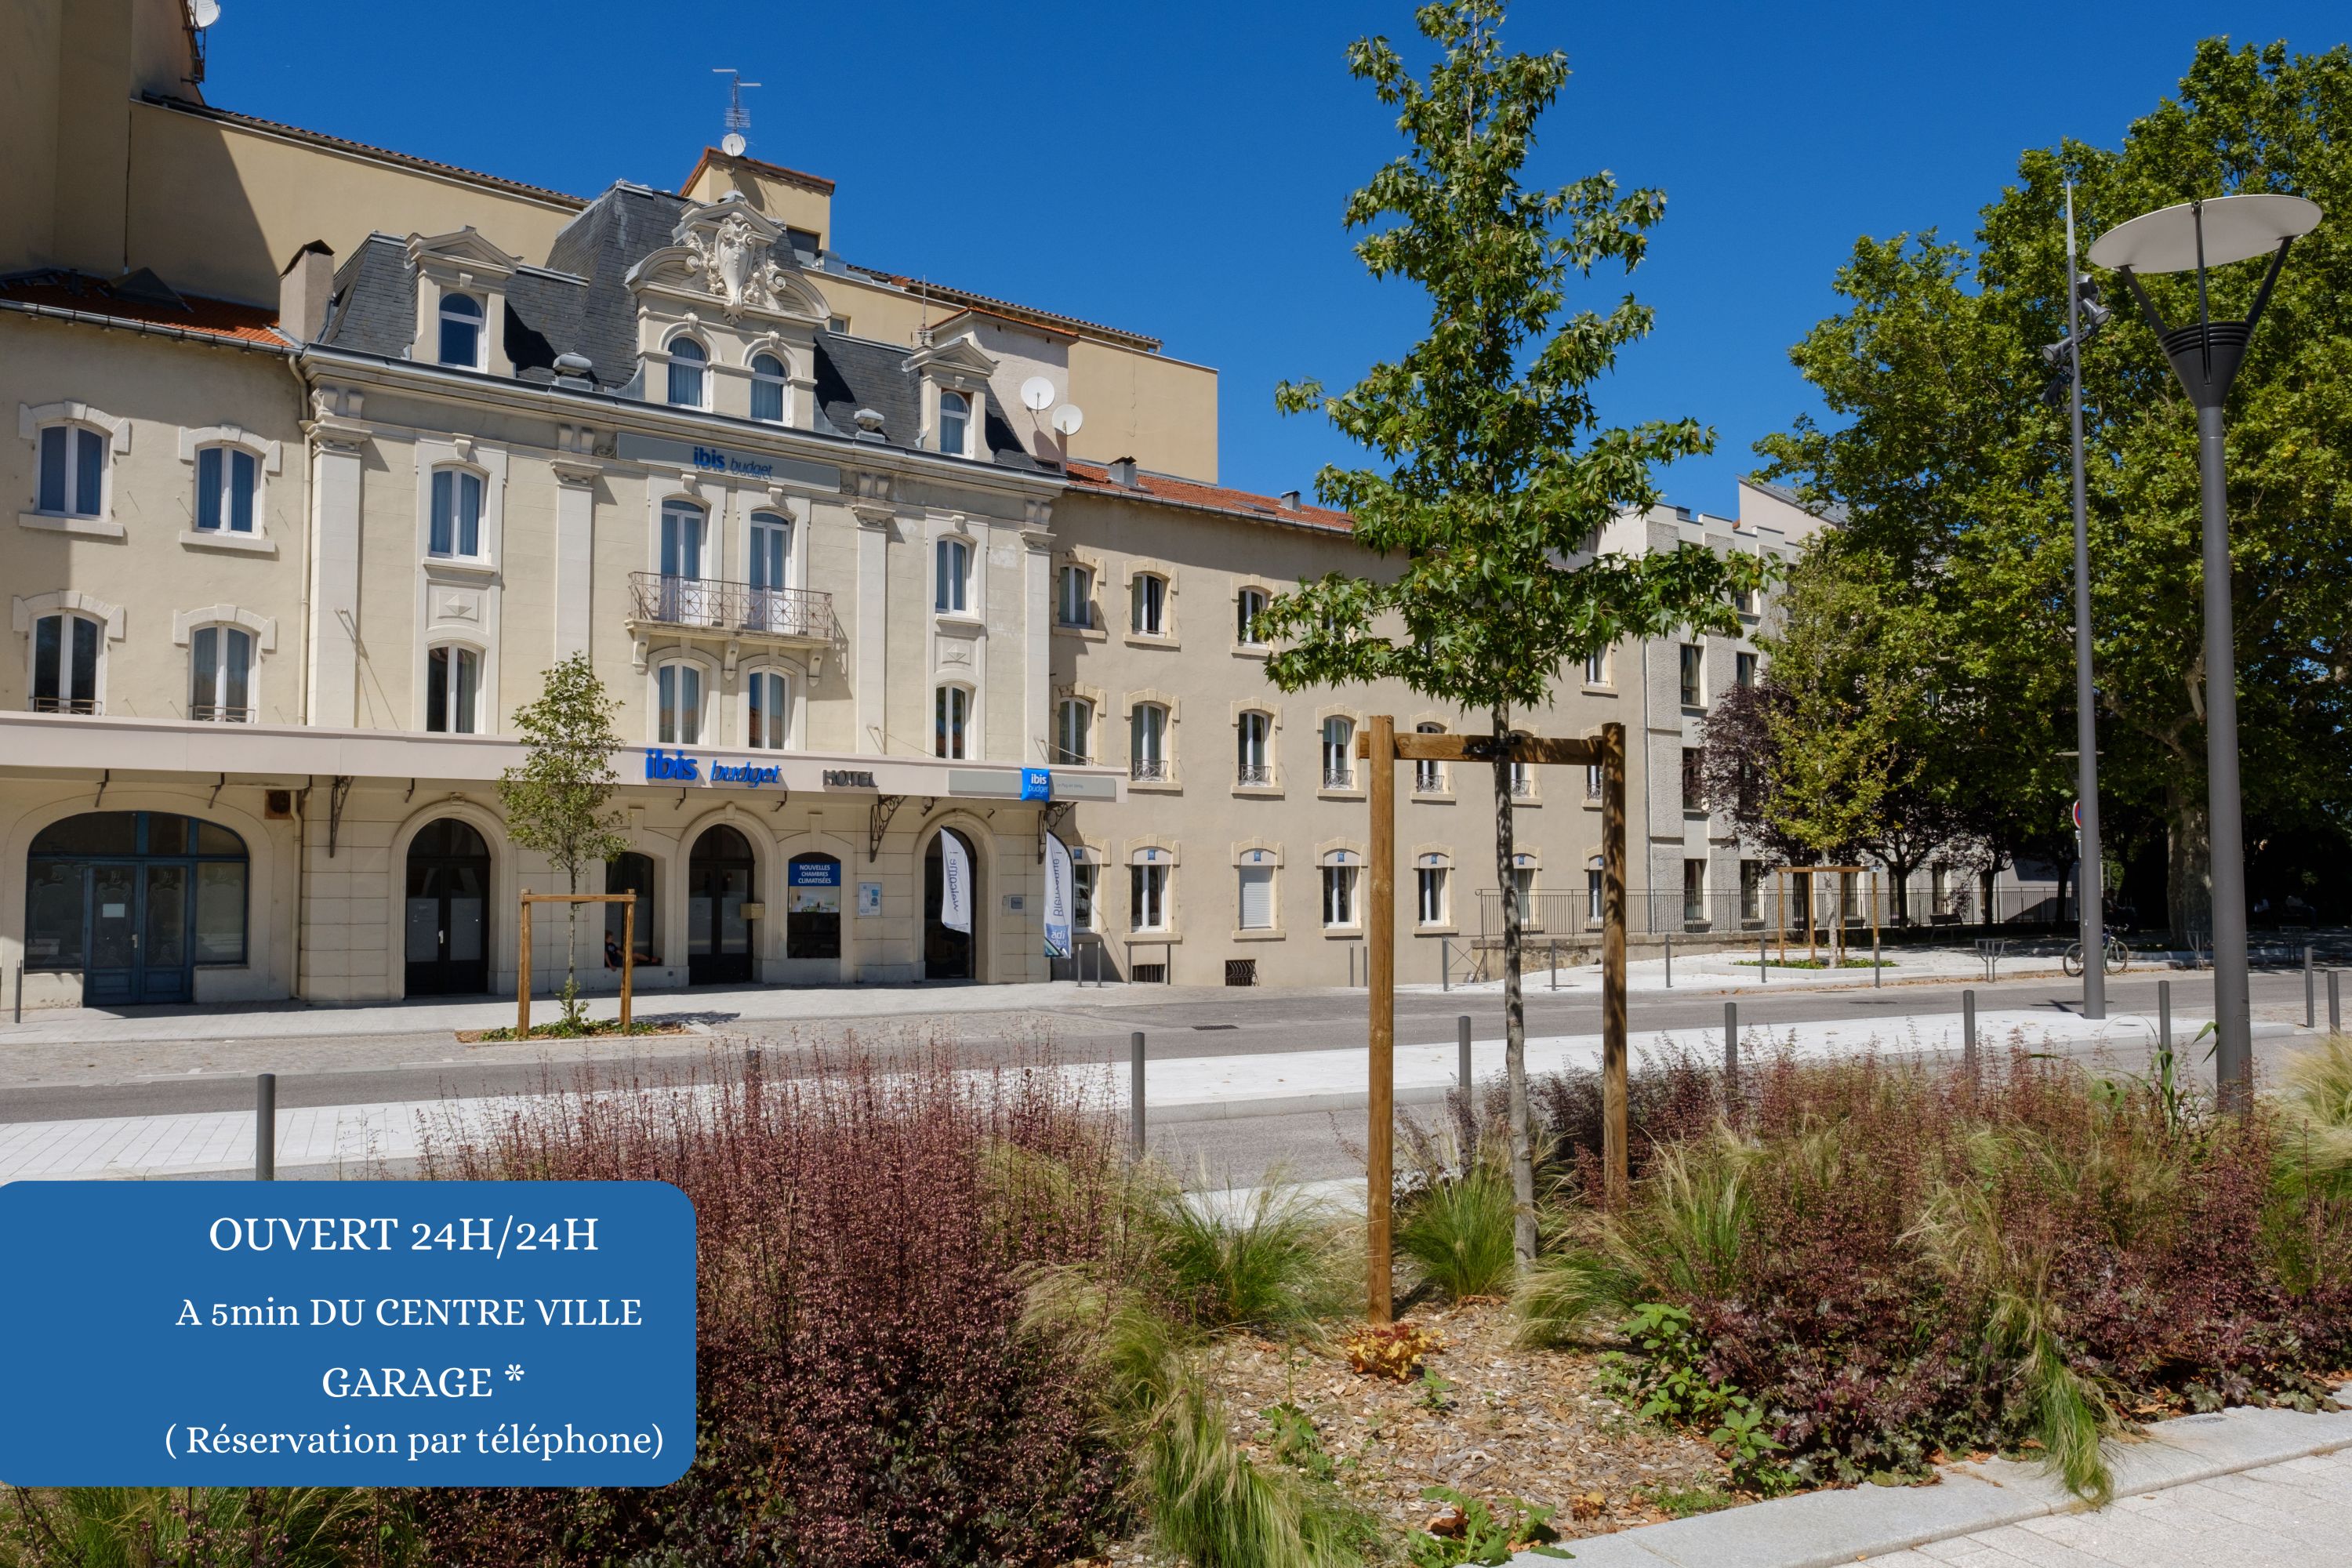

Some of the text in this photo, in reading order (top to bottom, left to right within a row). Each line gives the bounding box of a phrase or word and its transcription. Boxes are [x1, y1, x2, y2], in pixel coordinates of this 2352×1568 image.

[693, 446, 773, 477] ibis budget
[645, 749, 879, 788] ibis budget HOTEL
[1031, 773, 1047, 785] ibis
[1028, 785, 1048, 794] budget
